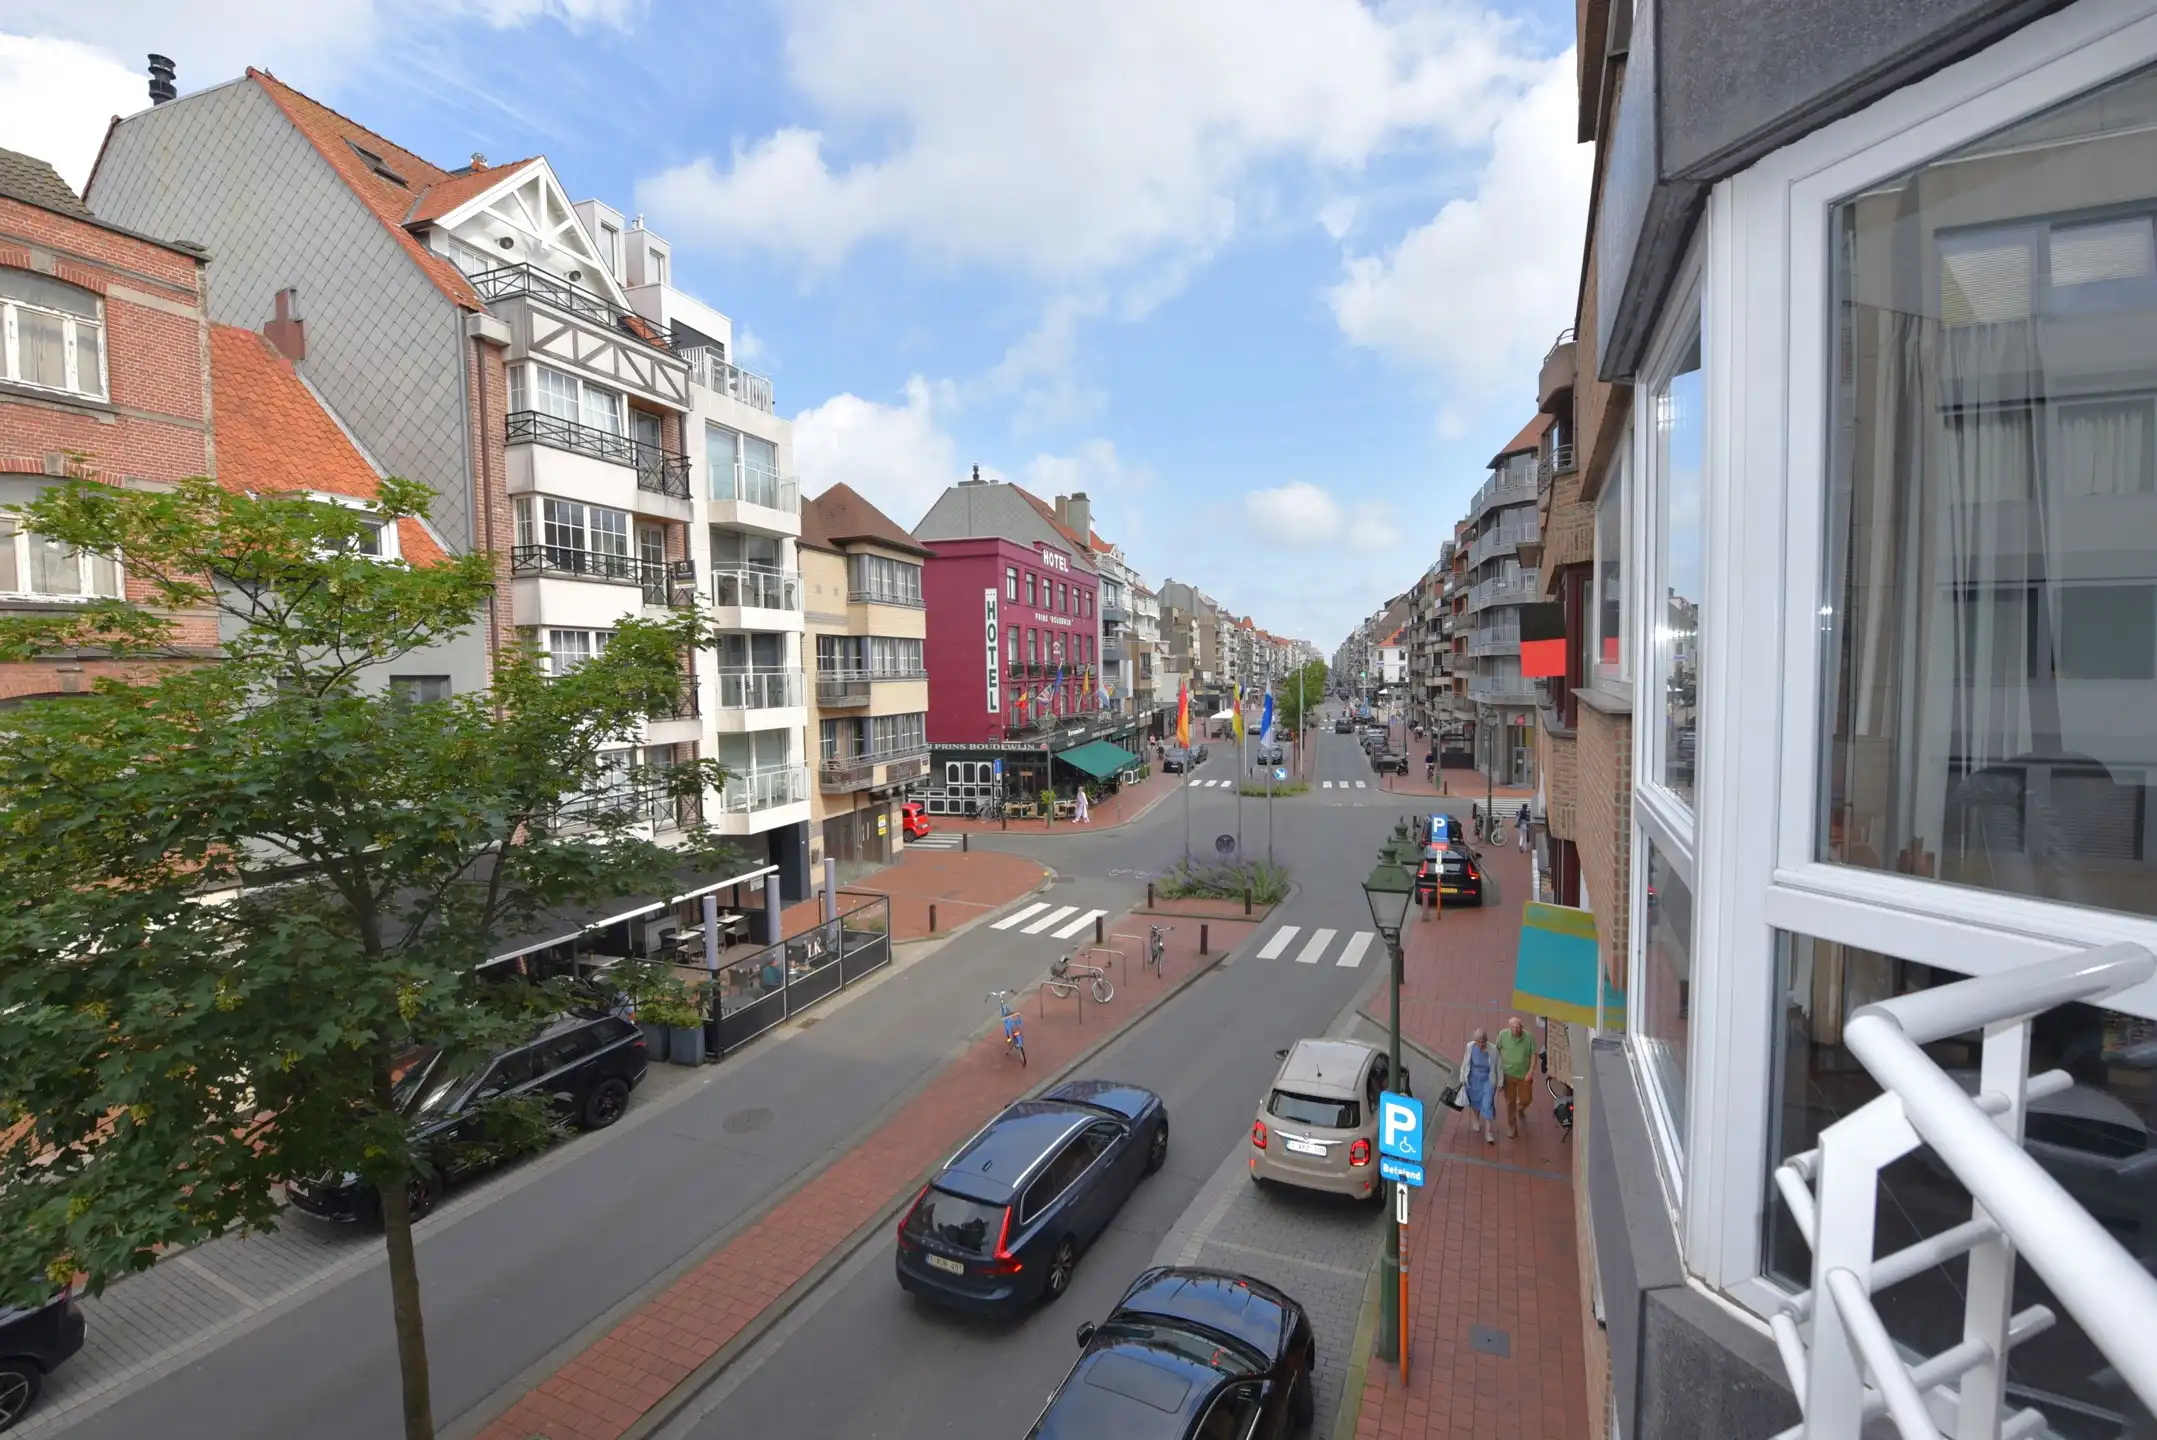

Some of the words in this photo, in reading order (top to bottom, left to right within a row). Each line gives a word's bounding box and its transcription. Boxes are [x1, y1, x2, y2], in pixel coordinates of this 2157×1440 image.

[1043, 549, 1068, 572] HOTEL
[987, 601, 997, 710] HOTEL
[1433, 817, 1445, 832] P
[1385, 1102, 1416, 1146] P
